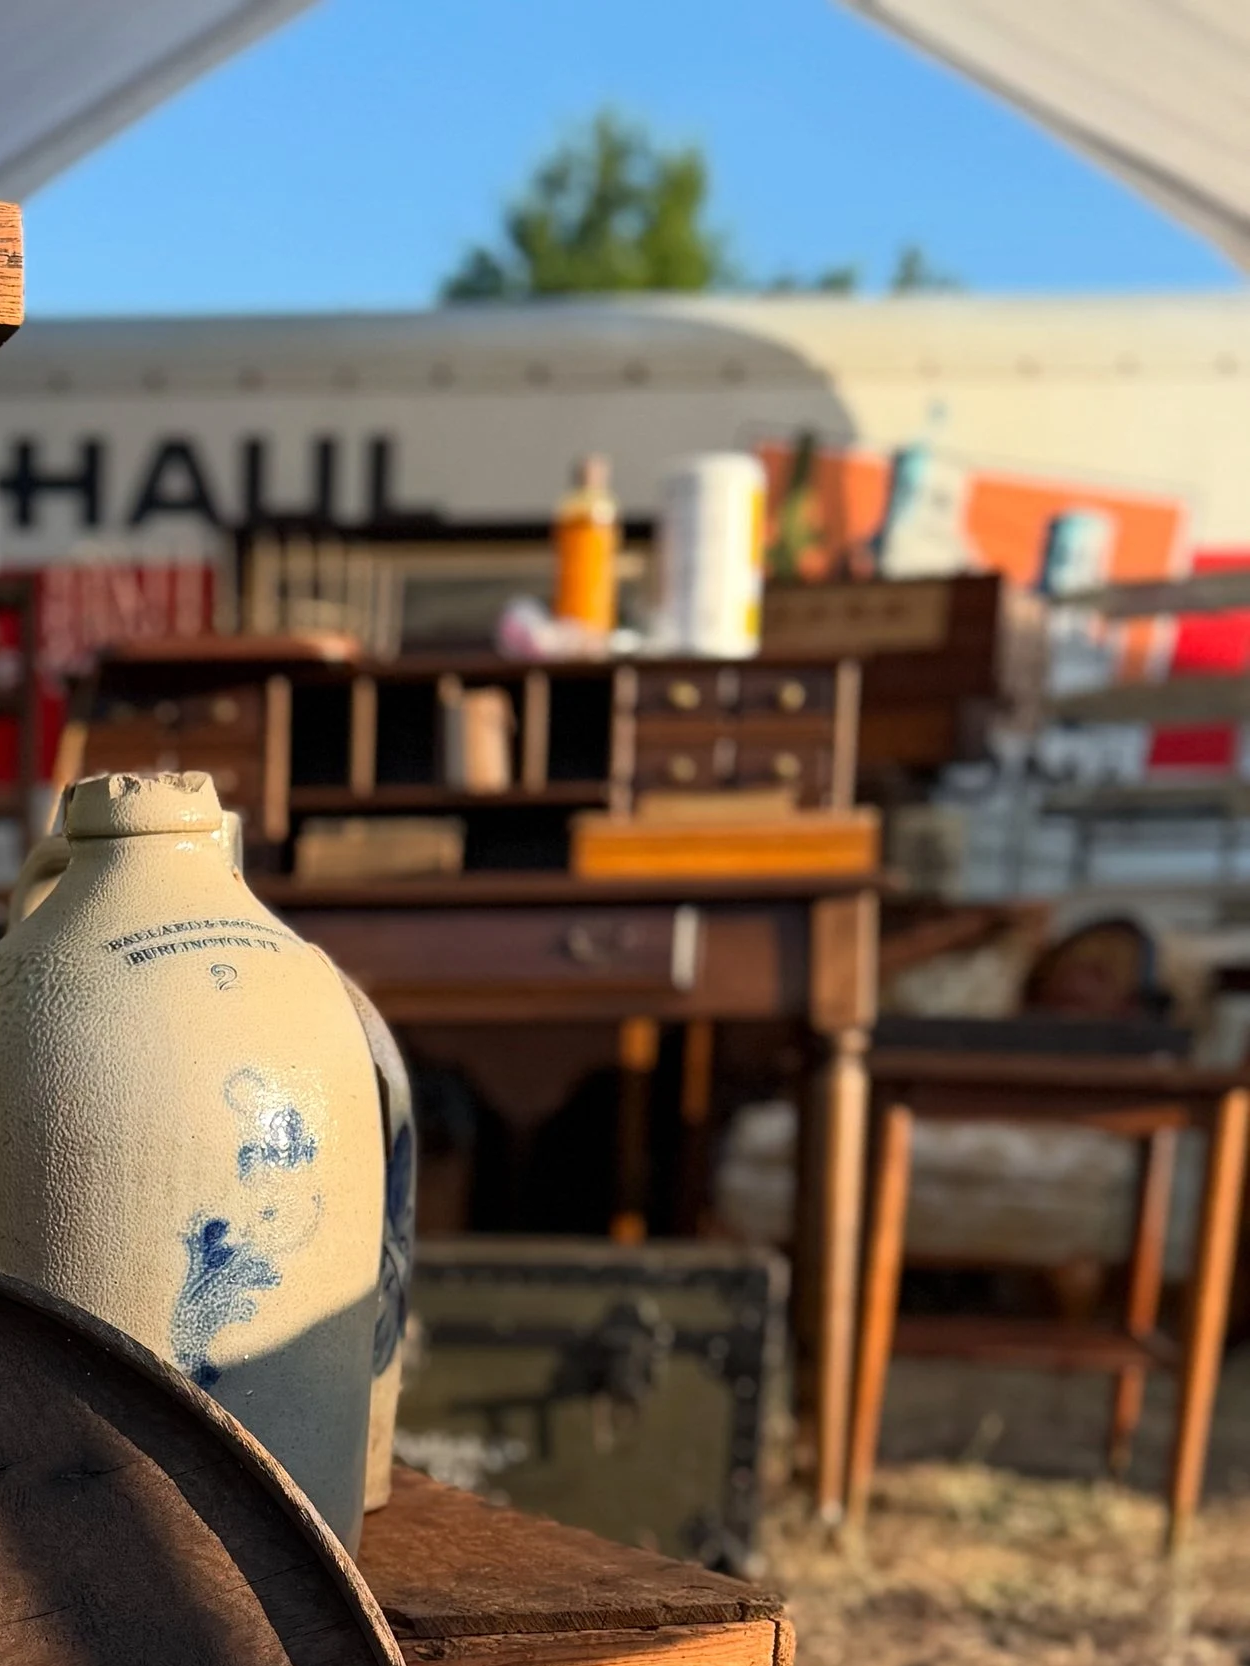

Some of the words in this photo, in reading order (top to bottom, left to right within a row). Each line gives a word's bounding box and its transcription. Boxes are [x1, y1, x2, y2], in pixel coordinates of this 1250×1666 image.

[106, 920, 201, 952] BALLARD
[126, 937, 252, 966] BURLINGTON
[210, 963, 243, 991] 2
